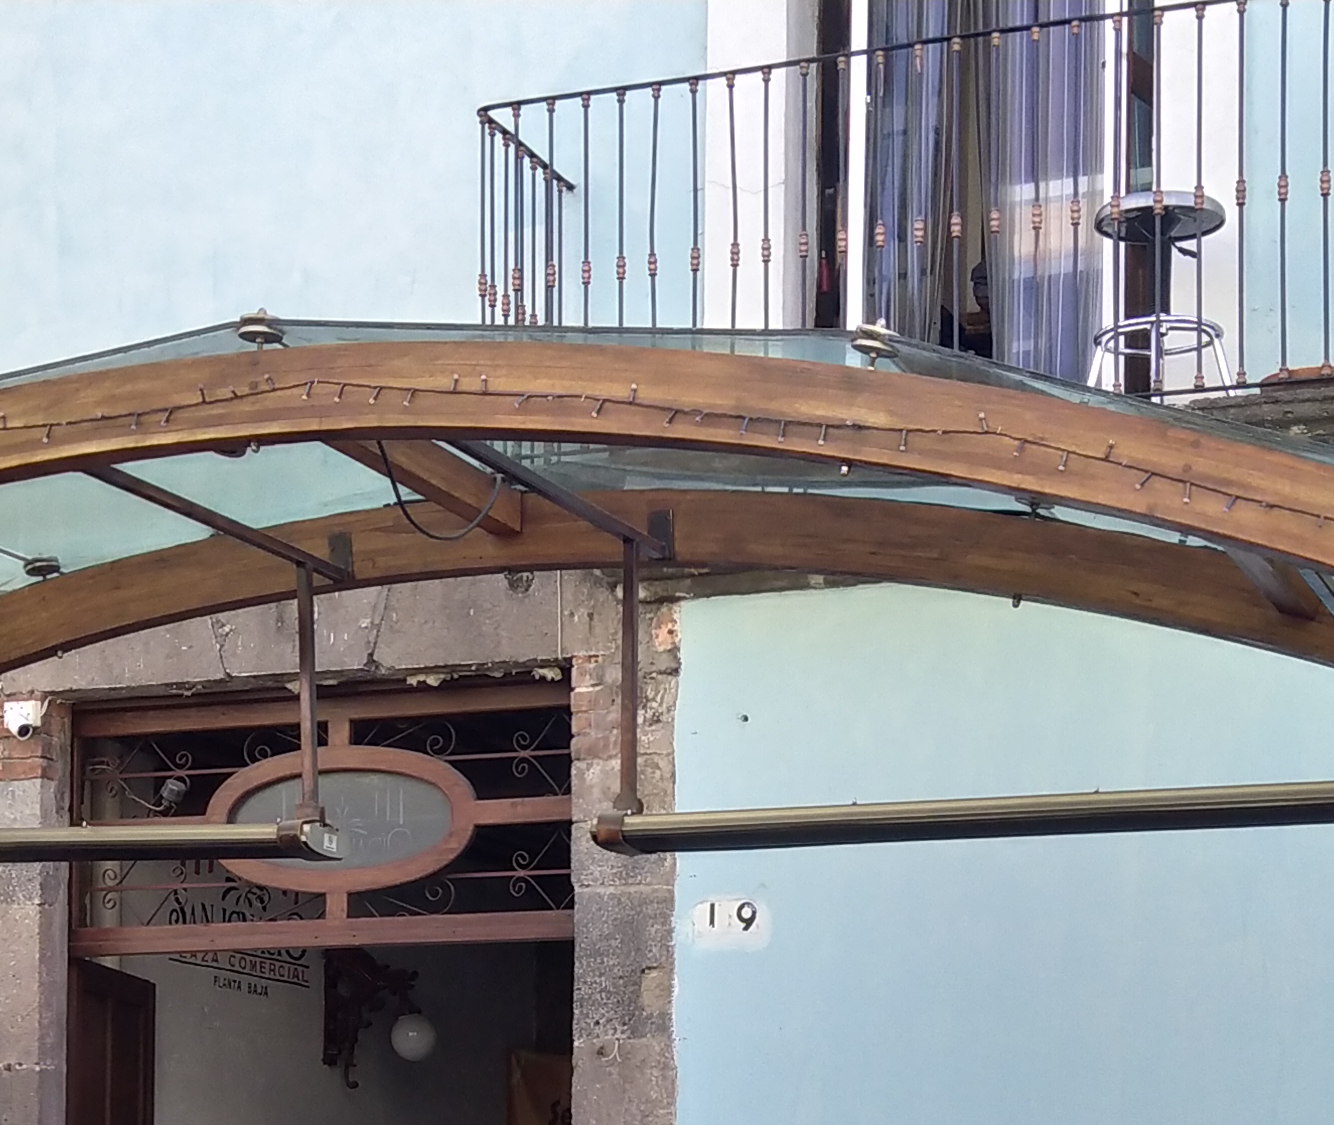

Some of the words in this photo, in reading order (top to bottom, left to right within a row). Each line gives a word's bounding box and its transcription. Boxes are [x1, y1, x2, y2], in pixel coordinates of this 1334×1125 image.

[709, 901, 757, 932] 19
[228, 954, 309, 984] COMERCIAL
[213, 975, 242, 993] PLANTA
[247, 981, 269, 998] BAJA
